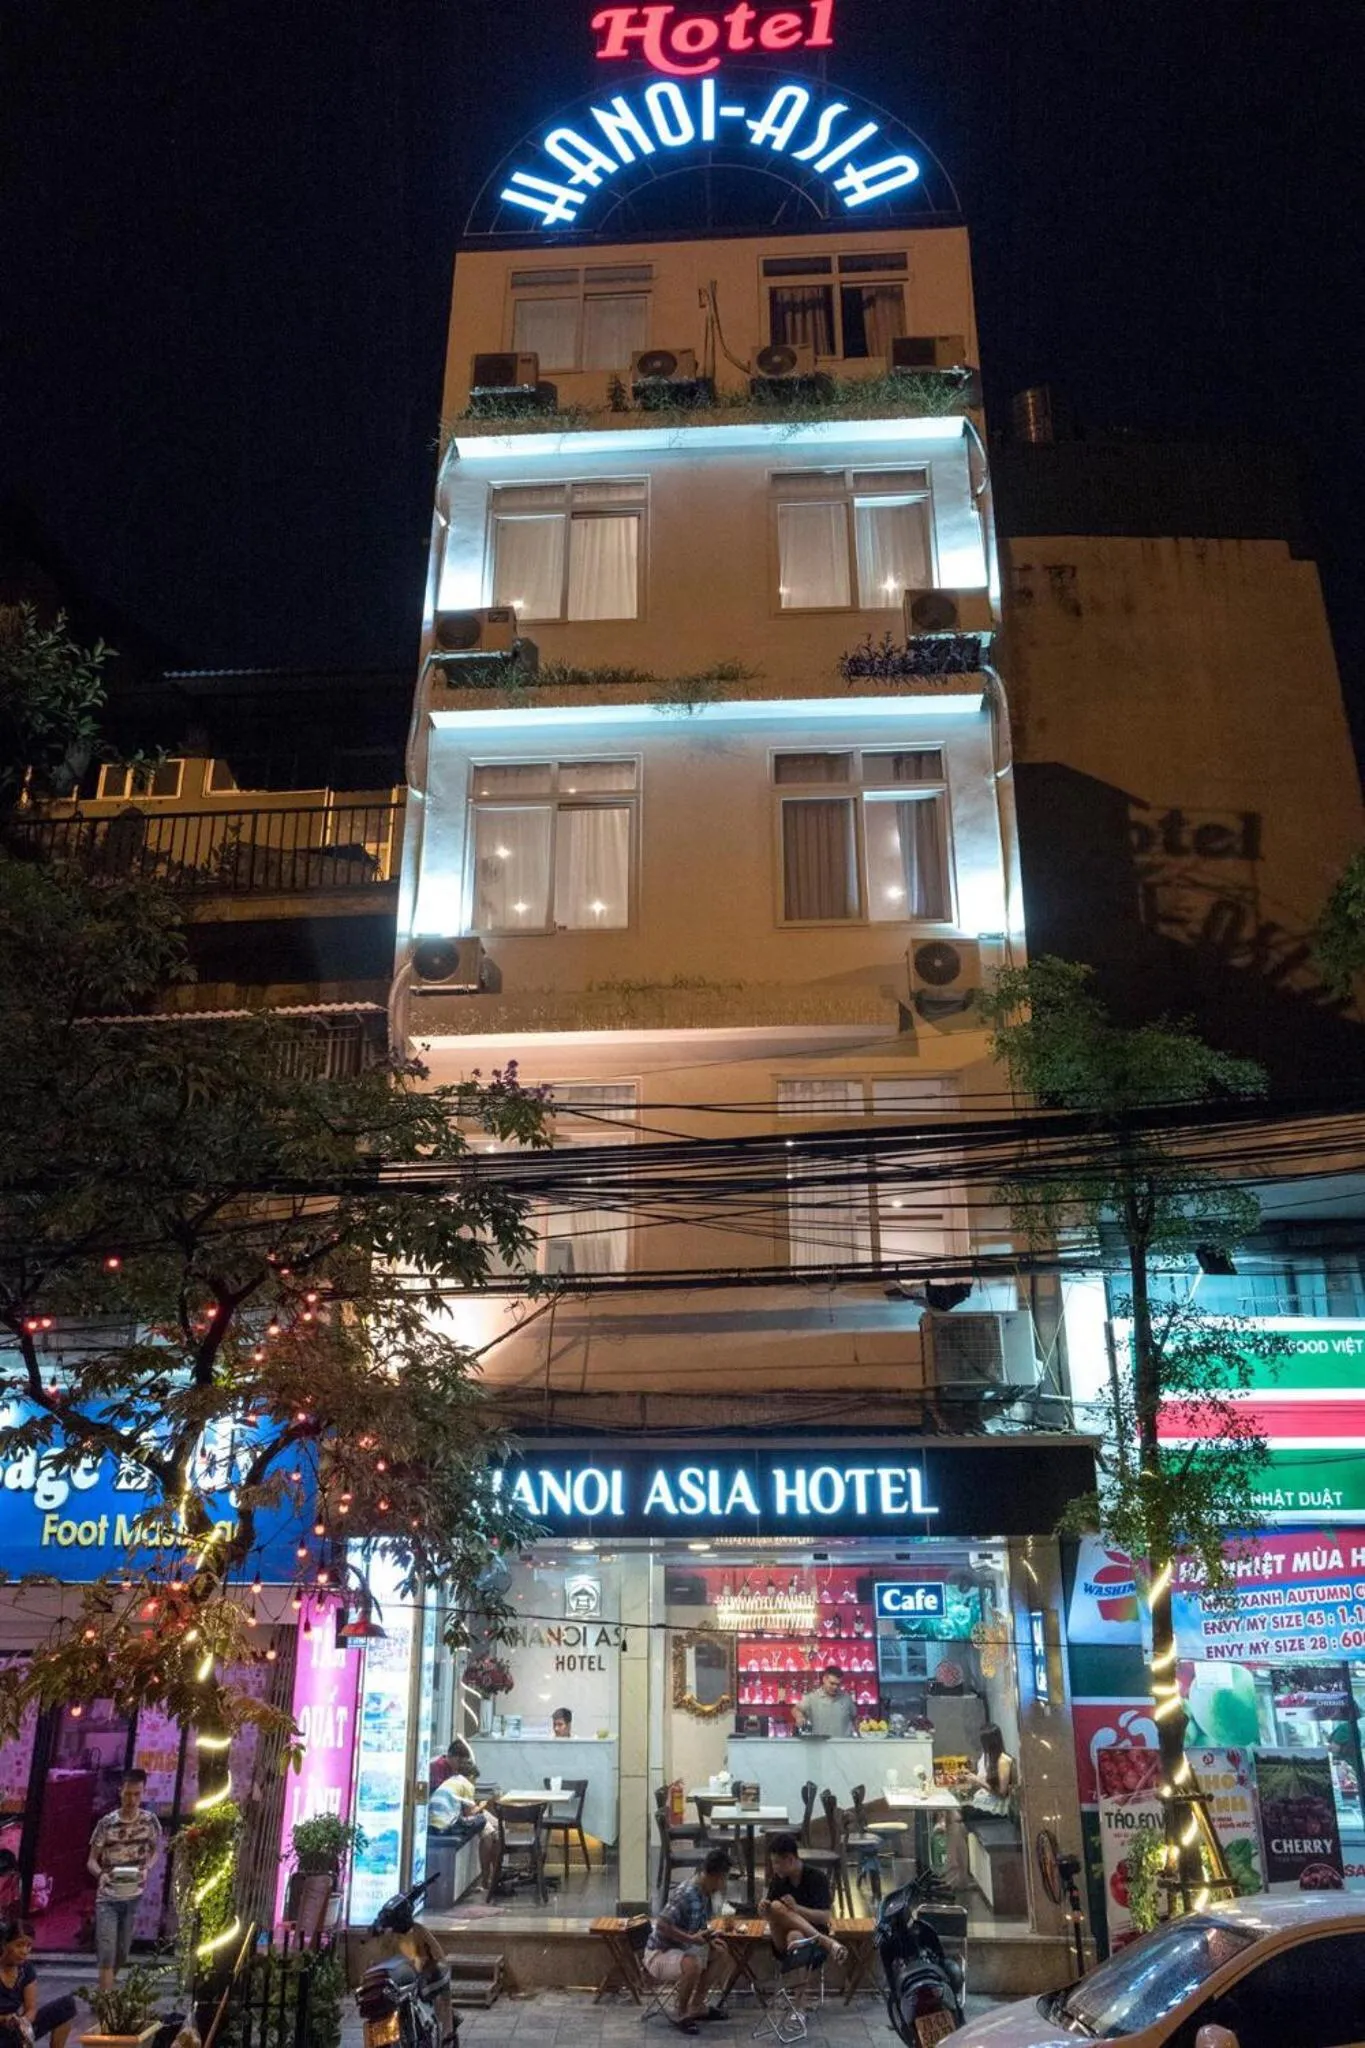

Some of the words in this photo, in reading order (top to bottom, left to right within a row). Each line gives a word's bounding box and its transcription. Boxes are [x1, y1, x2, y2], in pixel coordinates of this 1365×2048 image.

[592, 0, 833, 75] Hotel
[1331, 1336, 1364, 1357] VIỆT
[643, 1466, 761, 1516] ASIA
[773, 1467, 939, 1516] HOTEL
[1250, 1488, 1296, 1509] NHẬT
[1298, 1487, 1343, 1509] DUẬT
[42, 1513, 109, 1546] Foot
[1292, 1546, 1344, 1573] MÙA
[882, 1588, 939, 1611] Cafe
[1241, 1591, 1283, 1608] XANH
[1288, 1587, 1350, 1605] AUTUMN
[1204, 1620, 1242, 1635] ENVY
[1273, 1614, 1302, 1629] SIZE
[1307, 1612, 1324, 1626] 45
[1206, 1643, 1244, 1659] ENVY
[1275, 1637, 1305, 1653] SIZE
[1310, 1636, 1327, 1650] 28
[555, 1654, 606, 1671] HOTEL
[1104, 1808, 1136, 1829] TÁO
[1271, 1838, 1334, 1854] CHERRY
